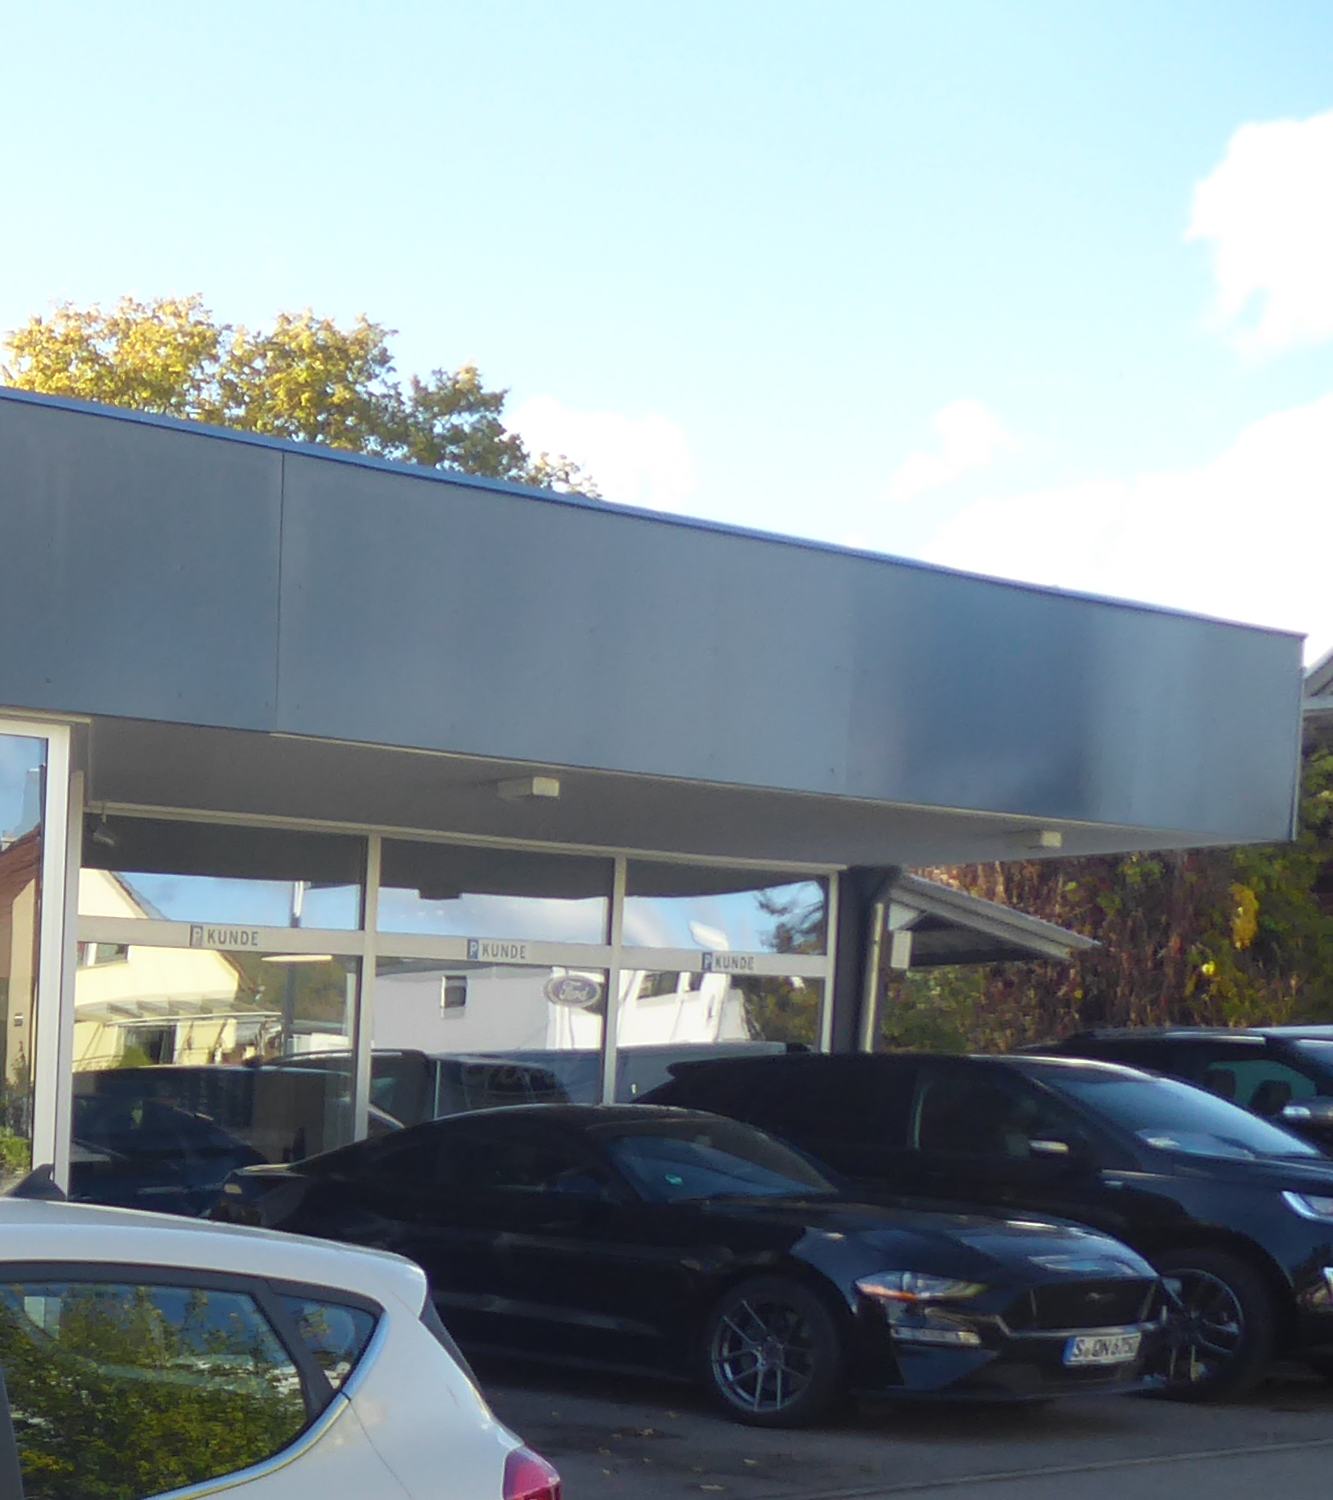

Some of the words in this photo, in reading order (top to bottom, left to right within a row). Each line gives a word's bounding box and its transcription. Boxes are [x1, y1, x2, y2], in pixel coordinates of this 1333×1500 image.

[207, 929, 259, 946] KUNDE
[482, 943, 526, 959] KUNDE
[715, 956, 754, 970] KUNDE
